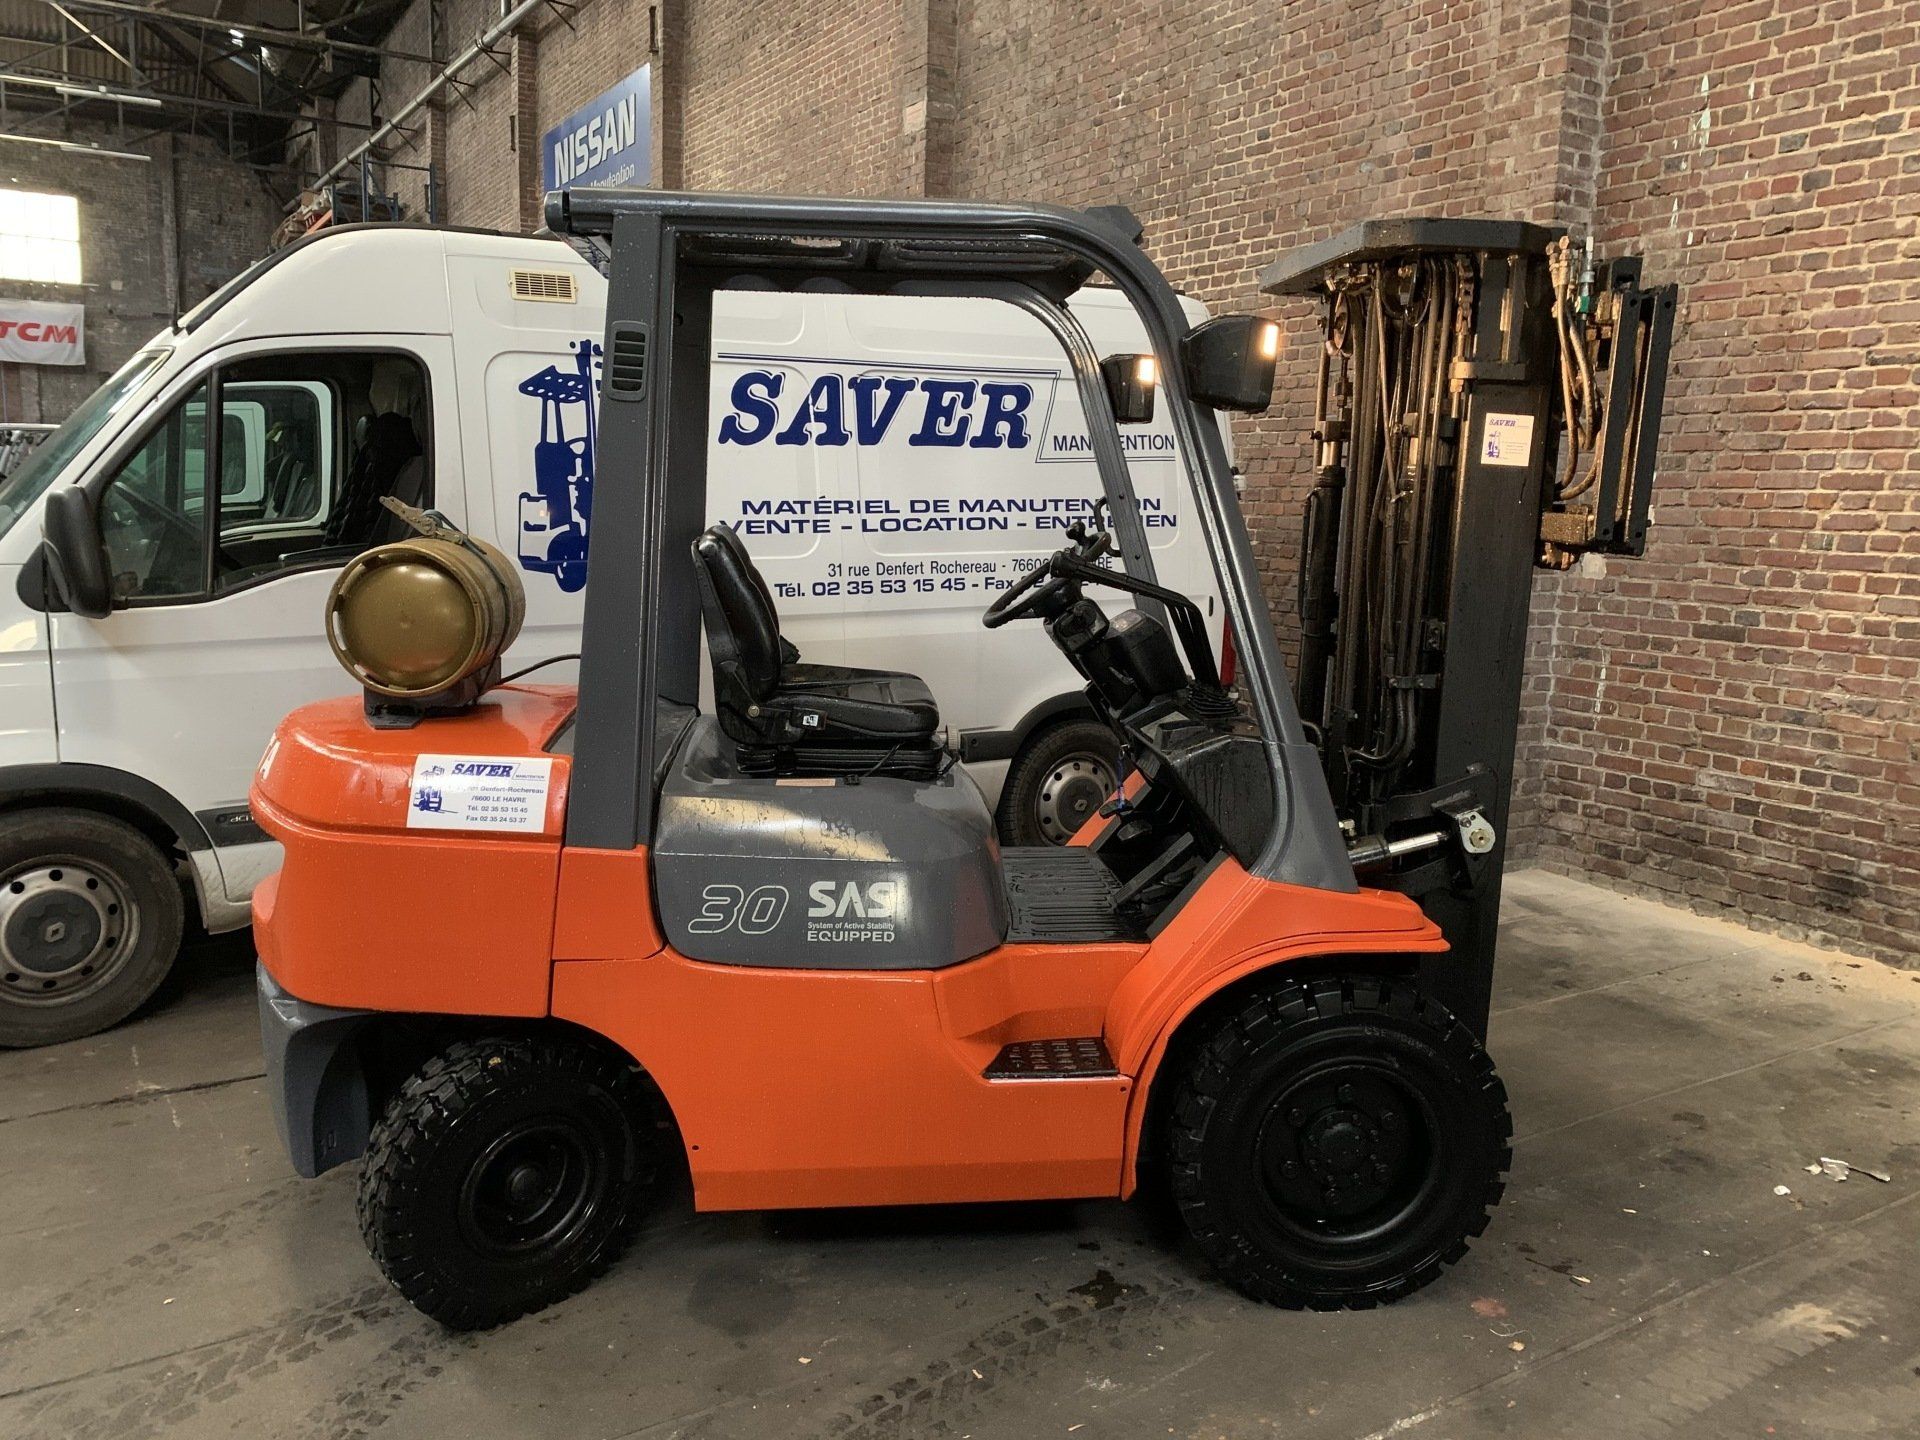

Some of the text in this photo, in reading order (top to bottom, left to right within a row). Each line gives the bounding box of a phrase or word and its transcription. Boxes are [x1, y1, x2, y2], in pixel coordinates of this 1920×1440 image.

[555, 93, 636, 189] NISSAN
[0, 321, 77, 344] TCM
[718, 370, 1034, 449] SAVER
[742, 495, 900, 515] MATÉRIEL
[909, 499, 950, 514] DE
[719, 518, 831, 535] VENTE
[861, 516, 1008, 533] LOCATION
[827, 562, 842, 577] 31
[848, 565, 870, 577] rue
[876, 561, 924, 577] Denfert
[930, 560, 996, 575] Rochereau
[774, 582, 806, 598] Tél.
[812, 581, 840, 596] 02
[846, 580, 873, 595] 35
[880, 579, 906, 594] 53
[912, 578, 934, 593] 15
[940, 577, 966, 592] 45
[984, 576, 1013, 591] Fax
[452, 763, 513, 778] SAVER
[688, 884, 790, 935] 30
[808, 881, 895, 918] SAS
[807, 921, 834, 931] System
[843, 922, 865, 930] Active
[866, 922, 895, 931] Stability
[807, 930, 895, 943] EQUIPPED
